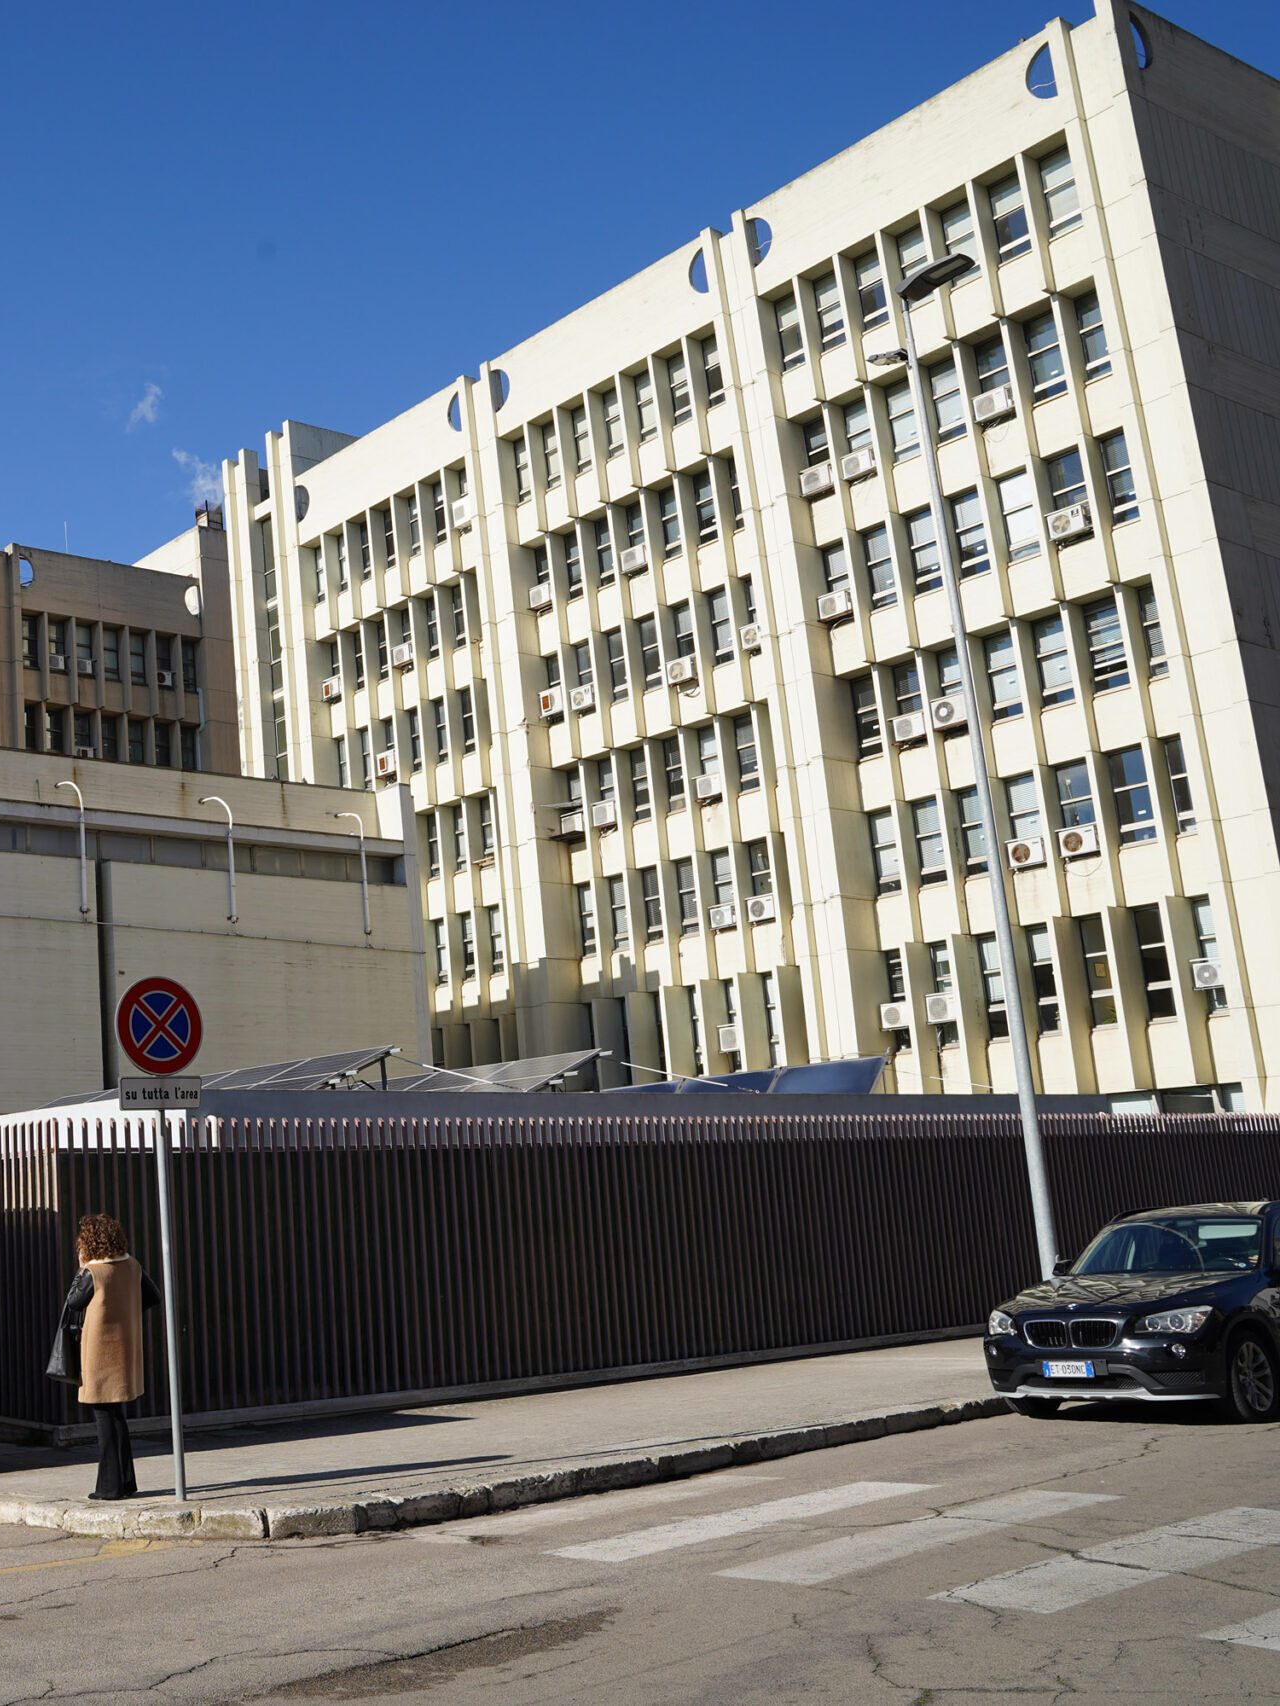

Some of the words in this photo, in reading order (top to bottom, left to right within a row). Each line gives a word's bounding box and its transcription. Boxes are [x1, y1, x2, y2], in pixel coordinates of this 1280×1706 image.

[125, 1090, 137, 1100] su
[142, 1088, 169, 1100] tutta
[175, 1086, 198, 1100] l'area
